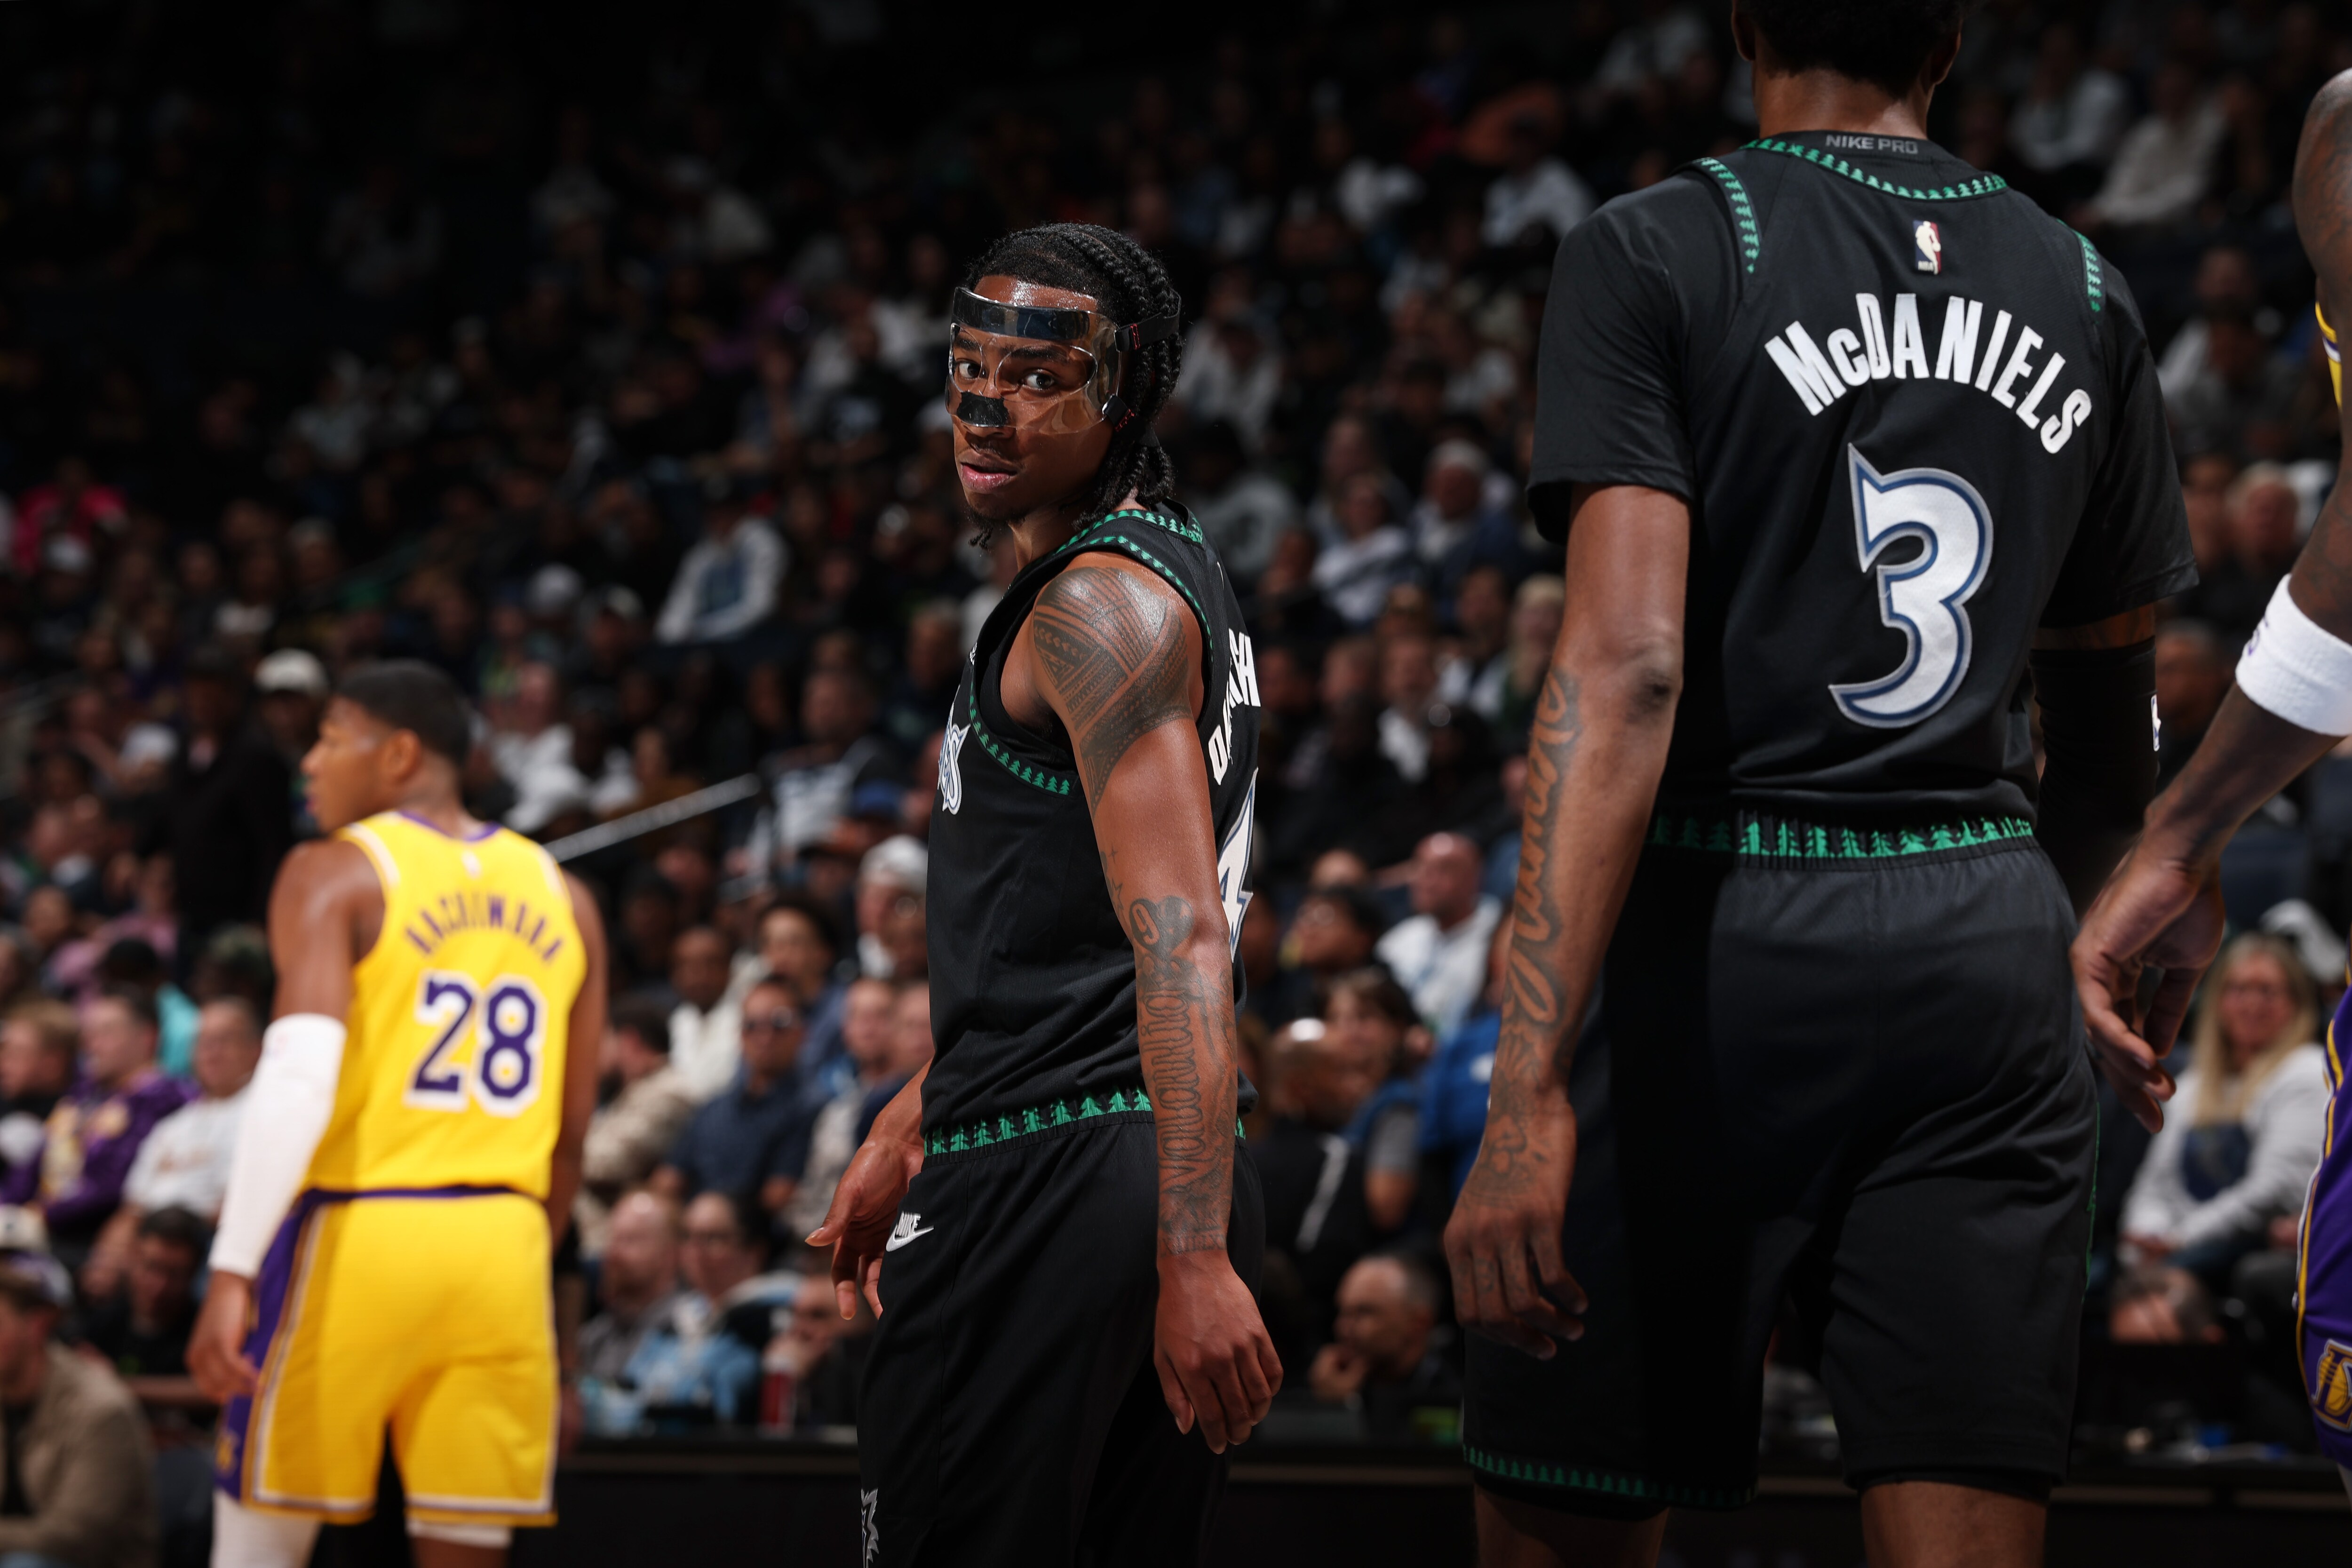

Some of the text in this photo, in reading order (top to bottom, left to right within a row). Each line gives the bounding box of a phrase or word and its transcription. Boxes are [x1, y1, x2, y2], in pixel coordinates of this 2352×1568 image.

[1825, 135, 1919, 154] NIKE PRO
[1828, 442, 1994, 728] 3
[402, 969, 548, 1118] 28
